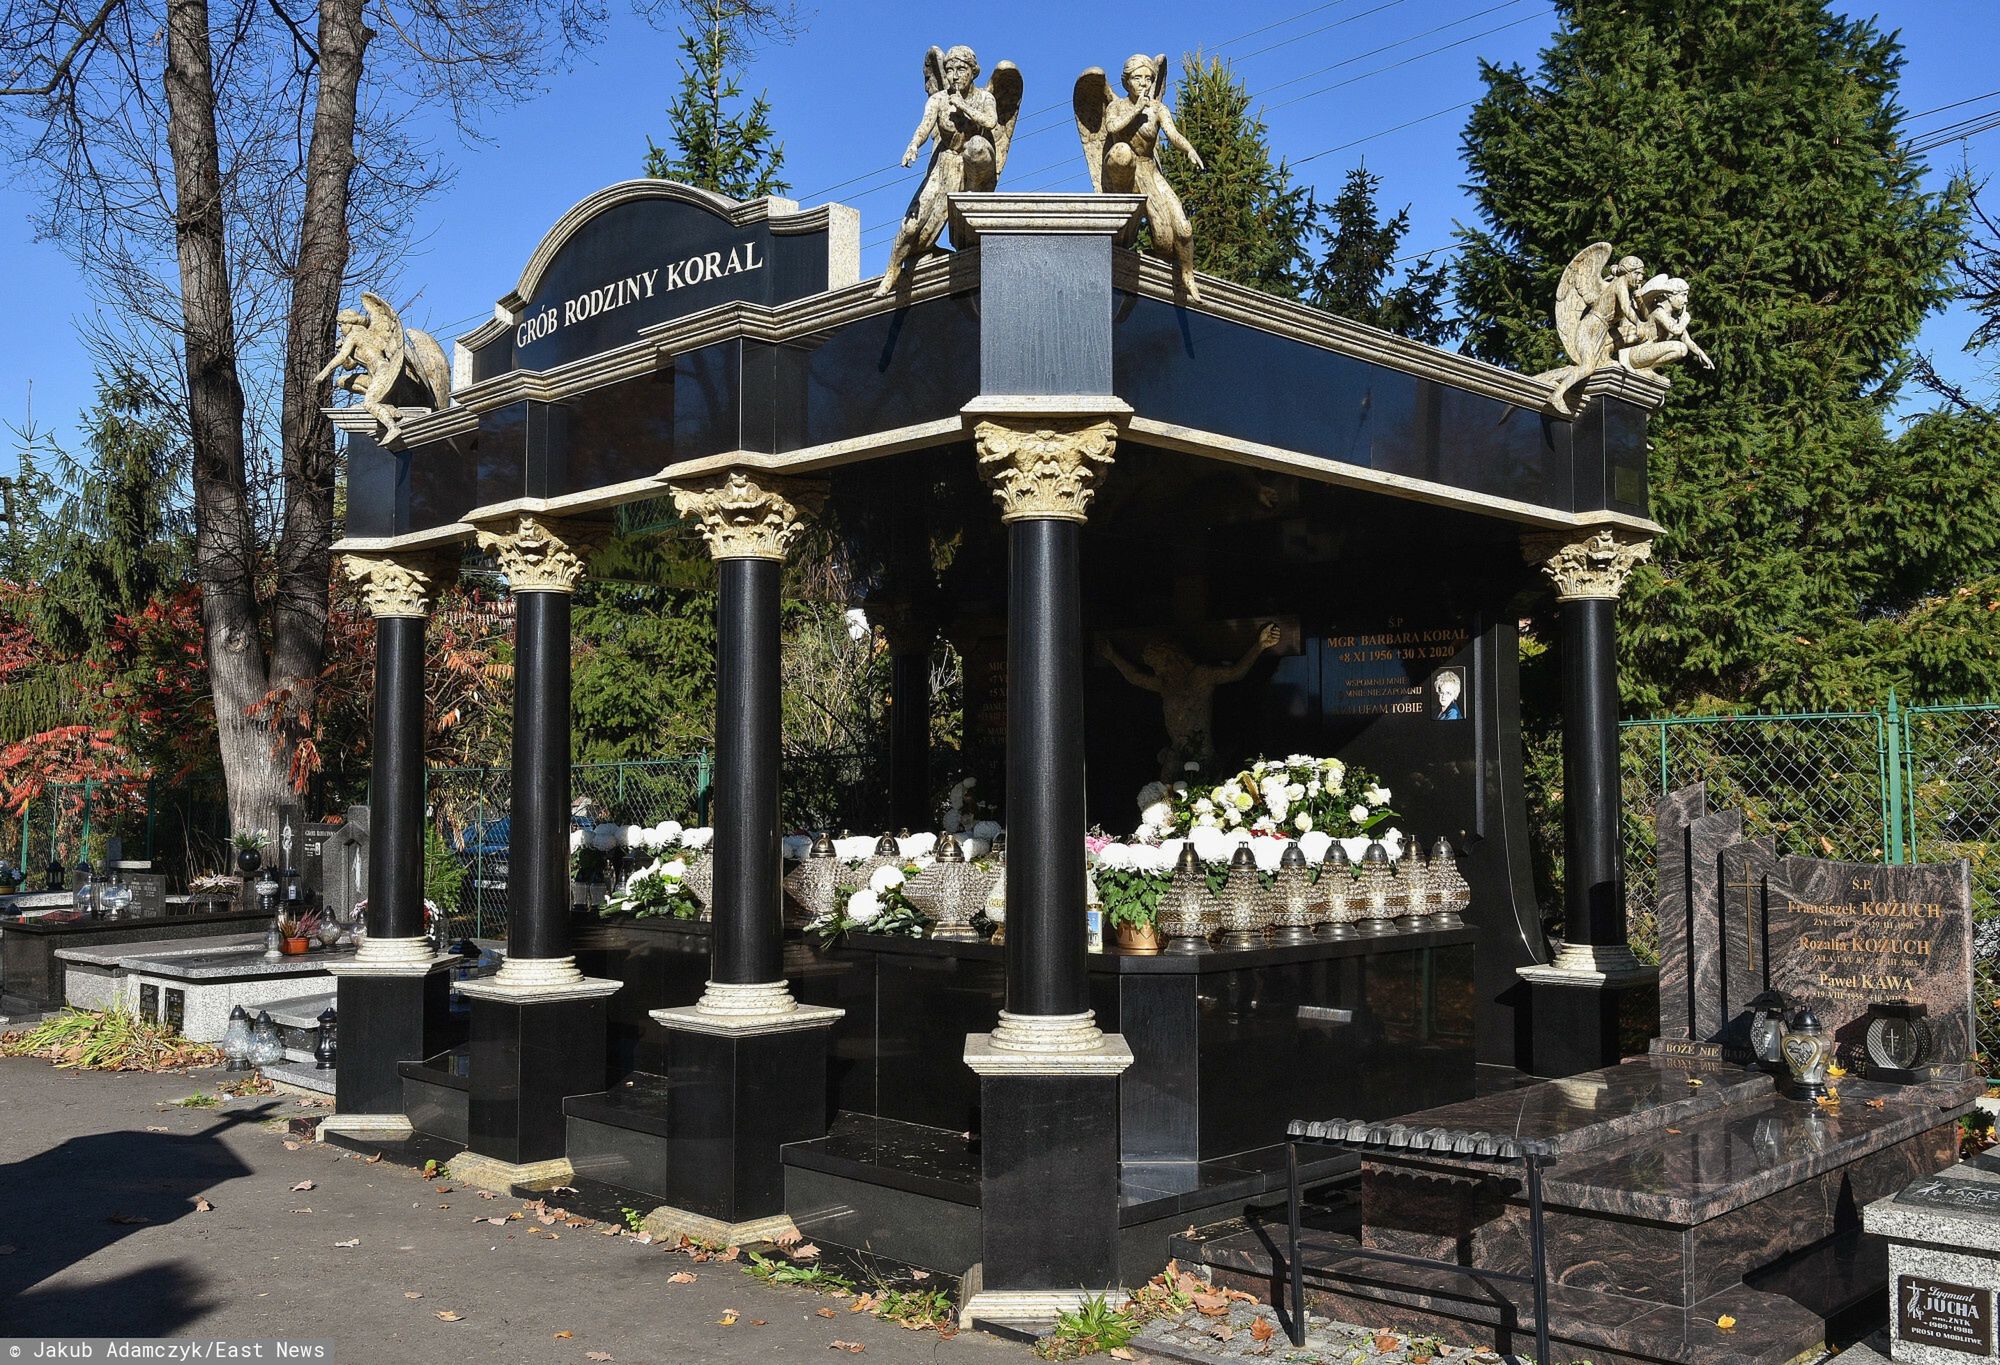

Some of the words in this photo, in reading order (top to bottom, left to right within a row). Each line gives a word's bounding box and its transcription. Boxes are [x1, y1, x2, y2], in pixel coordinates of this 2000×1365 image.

[516, 304, 558, 349] GRÓB
[564, 268, 658, 328] RODZINY
[665, 241, 764, 292] KORAL
[1327, 636, 1356, 648] MGR
[1361, 632, 1420, 646] BARBARA
[1423, 628, 1469, 643] KORAL
[1370, 650, 1393, 662] 1956
[1418, 646, 1427, 659] X
[1429, 645, 1455, 659] 2020
[1391, 701, 1424, 714] TOBIE
[1787, 900, 1857, 916] Franciszek
[1862, 899, 1942, 918] KOŻUCH
[1799, 936, 1849, 951] Rozalia
[1852, 935, 1932, 955] KOŻUCH
[1862, 974, 1914, 991] KAWA
[1666, 1043, 1695, 1055] BOŻE
[1699, 1046, 1719, 1057] NIE
[1928, 1286, 1976, 1302] Zygmunt
[1923, 1297, 1980, 1319] JUCHA
[1911, 1327, 1934, 1337] PROSI
